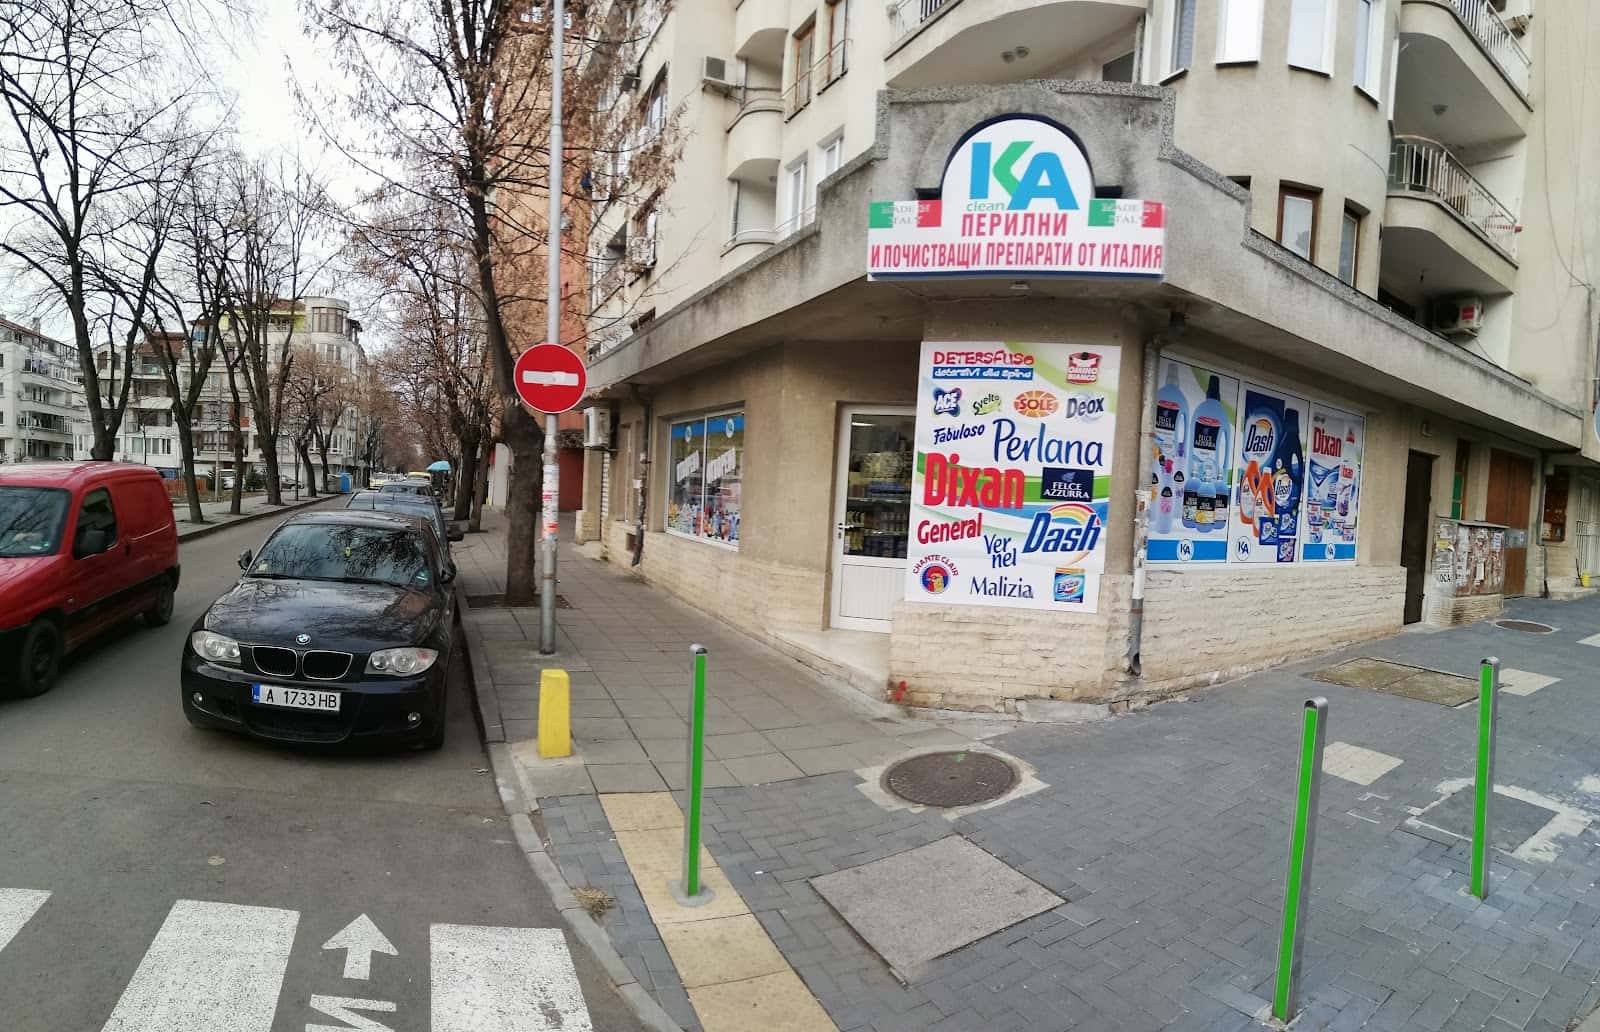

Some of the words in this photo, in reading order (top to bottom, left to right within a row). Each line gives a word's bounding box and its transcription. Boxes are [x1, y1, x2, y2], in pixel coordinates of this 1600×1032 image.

[966, 200, 1004, 212] clean
[961, 213, 1068, 237] ПЕРИЛНИ
[870, 245, 881, 268] И
[883, 242, 981, 269] ПОЧИСТВАЩИ
[985, 242, 1072, 267] ПРЕПАРАТИ
[1078, 243, 1096, 267] ОТ
[1100, 243, 1163, 269] ИТАЛИЯ
[935, 392, 958, 412] ACE
[1018, 399, 1054, 411] SOLE
[1066, 397, 1104, 418] Deox
[933, 424, 985, 445] Fabuloso
[992, 418, 1104, 467] Perlana
[1244, 424, 1273, 452] Dash
[1312, 426, 1342, 457] Dixan
[924, 452, 1025, 510] Dixan
[1052, 481, 1082, 491] FELCE
[1043, 488, 1089, 499] AZZURRA
[917, 512, 983, 545] General
[1021, 511, 1100, 554] Dash
[984, 534, 1012, 555] Ver
[912, 554, 941, 574] CHANTE
[941, 556, 959, 577] CLAIR
[992, 547, 1017, 569] nel
[969, 575, 1034, 600] Malizia
[284, 690, 316, 706] 1733
